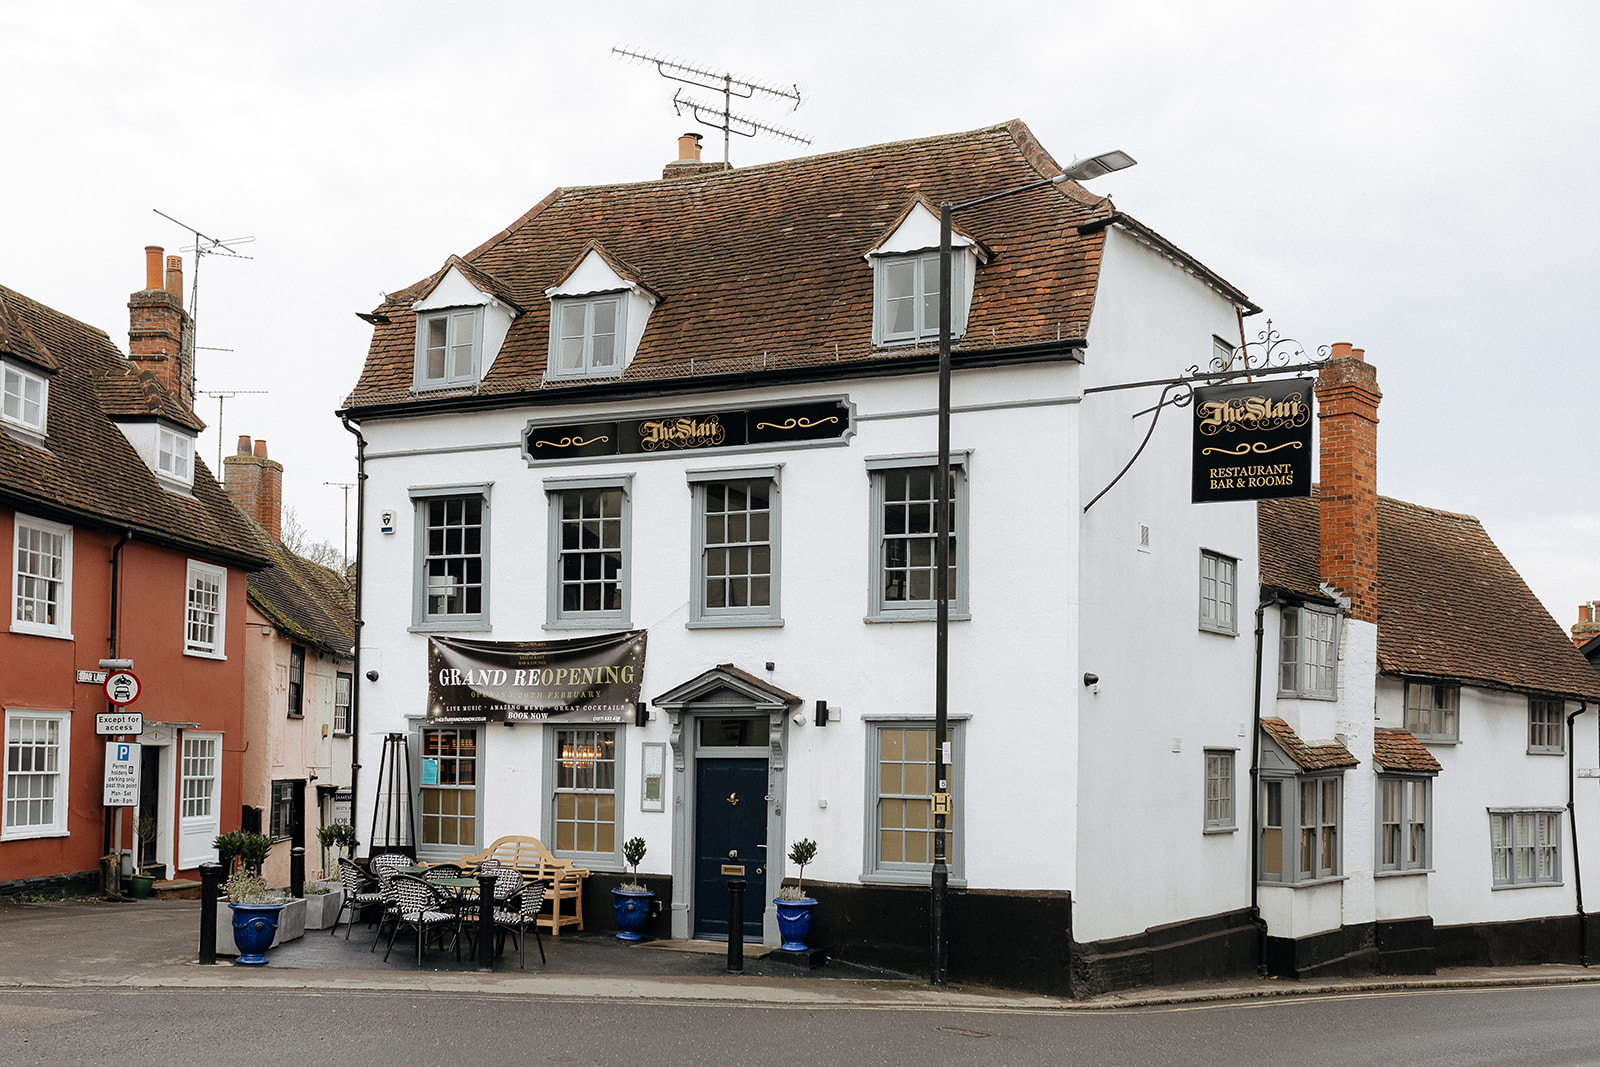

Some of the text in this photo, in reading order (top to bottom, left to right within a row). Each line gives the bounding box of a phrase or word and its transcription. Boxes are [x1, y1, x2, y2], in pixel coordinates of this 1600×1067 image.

[1242, 394, 1304, 422] Starr
[674, 416, 721, 440] Starr
[1209, 463, 1294, 479] RESTAURANT,
[1209, 475, 1294, 490] BAR & ROOMS
[438, 665, 635, 687] GRAND REOPENING
[470, 690, 513, 699] OPENING
[547, 690, 601, 699] FEBRUARY
[99, 716, 126, 724] Except
[507, 712, 549, 720] BOOK NOW
